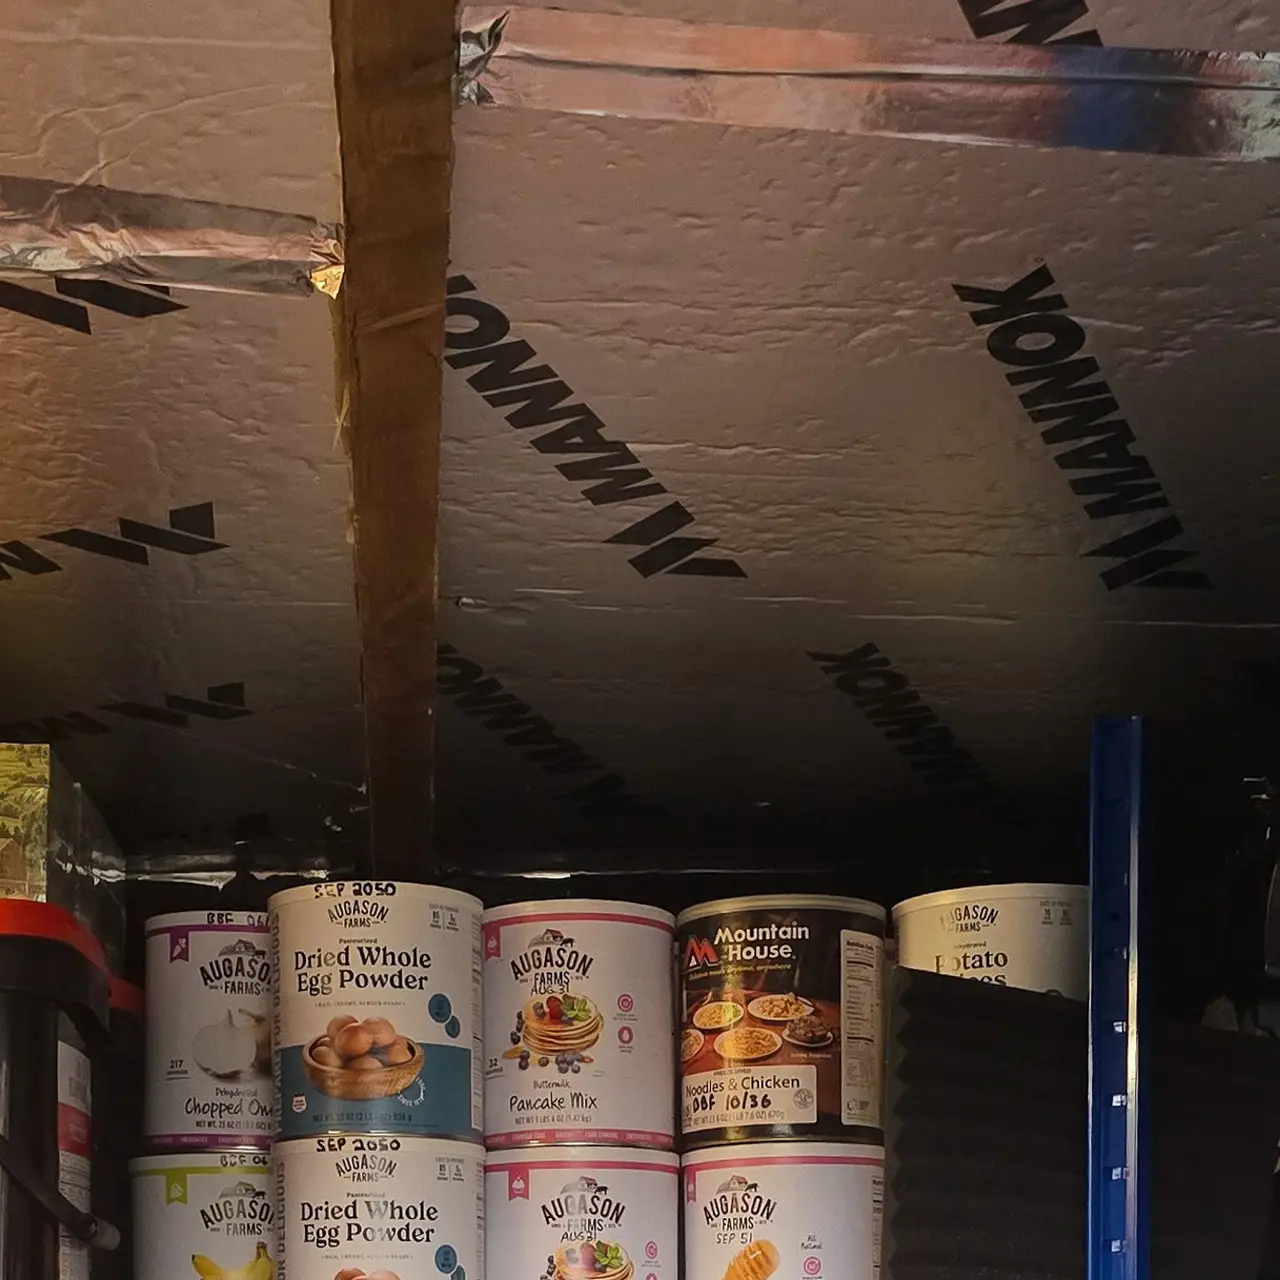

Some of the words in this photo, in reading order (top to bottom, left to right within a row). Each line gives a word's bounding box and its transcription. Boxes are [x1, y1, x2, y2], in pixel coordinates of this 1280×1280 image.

[444, 274, 669, 506] MANNO
[951, 264, 1170, 520] MANNOK
[436, 644, 610, 776] MANNO
[353, 883, 396, 896] 2050
[714, 922, 809, 945] Mountain
[295, 947, 350, 971] Dried
[358, 946, 432, 968] Whole
[510, 947, 593, 981] AUGASON
[729, 944, 792, 961] House
[224, 979, 261, 995] FARMS
[298, 971, 332, 995] Egg
[339, 969, 429, 991] Powder
[686, 1081, 724, 1098] Noodles
[741, 1075, 800, 1090] Chicken
[185, 1097, 242, 1118] Chopped
[509, 1092, 566, 1111] Pancake
[570, 1092, 597, 1109] Mix
[726, 1091, 771, 1110] 10/36
[316, 1138, 347, 1152] SEP
[301, 1201, 357, 1222] Dried
[365, 1201, 438, 1221] Whole
[704, 1195, 777, 1225] AUGASON
[303, 1224, 339, 1248] Egg
[346, 1223, 435, 1243] Powder
[716, 1232, 735, 1244] SEP
